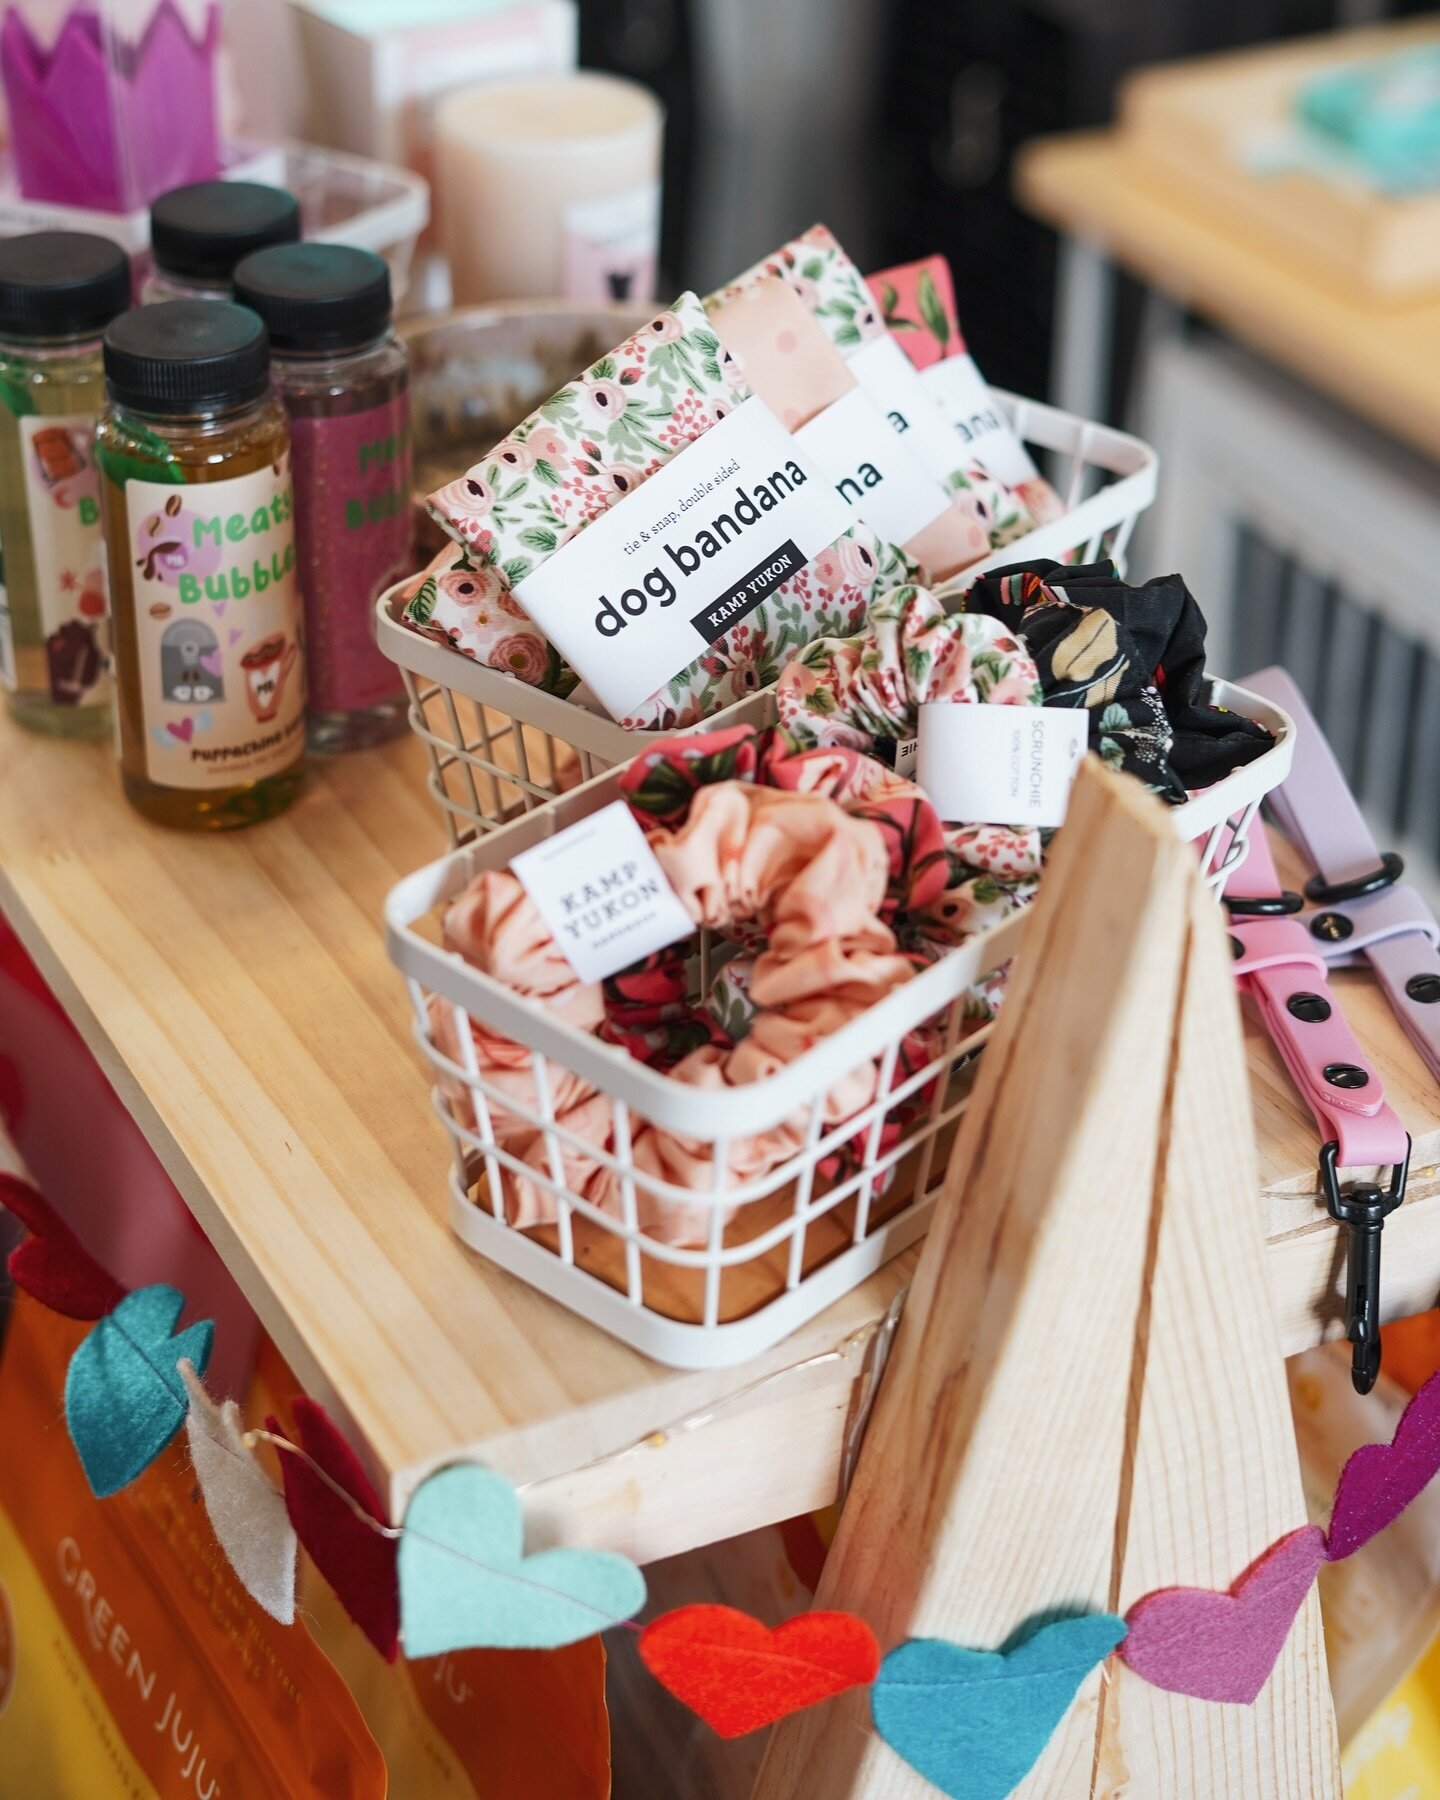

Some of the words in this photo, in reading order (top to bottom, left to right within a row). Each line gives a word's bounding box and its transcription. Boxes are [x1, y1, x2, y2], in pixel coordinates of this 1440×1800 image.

[623, 539, 642, 556] tie
[639, 531, 652, 543] &
[651, 511, 681, 536] snap,
[679, 483, 713, 512] double
[714, 458, 741, 486] sided
[835, 462, 884, 506] na
[595, 567, 678, 637] dog
[662, 460, 808, 577] bandana
[707, 591, 748, 628] KAMP
[747, 553, 793, 594] YUKON
[1010, 755, 1021, 798] COTTON
[1029, 720, 1044, 808] SCRUNCHIE
[561, 861, 638, 914] KAMP
[563, 878, 659, 939] YUKON
[57, 1536, 157, 1701] GREEN
[154, 1692, 216, 1800] JUJU
